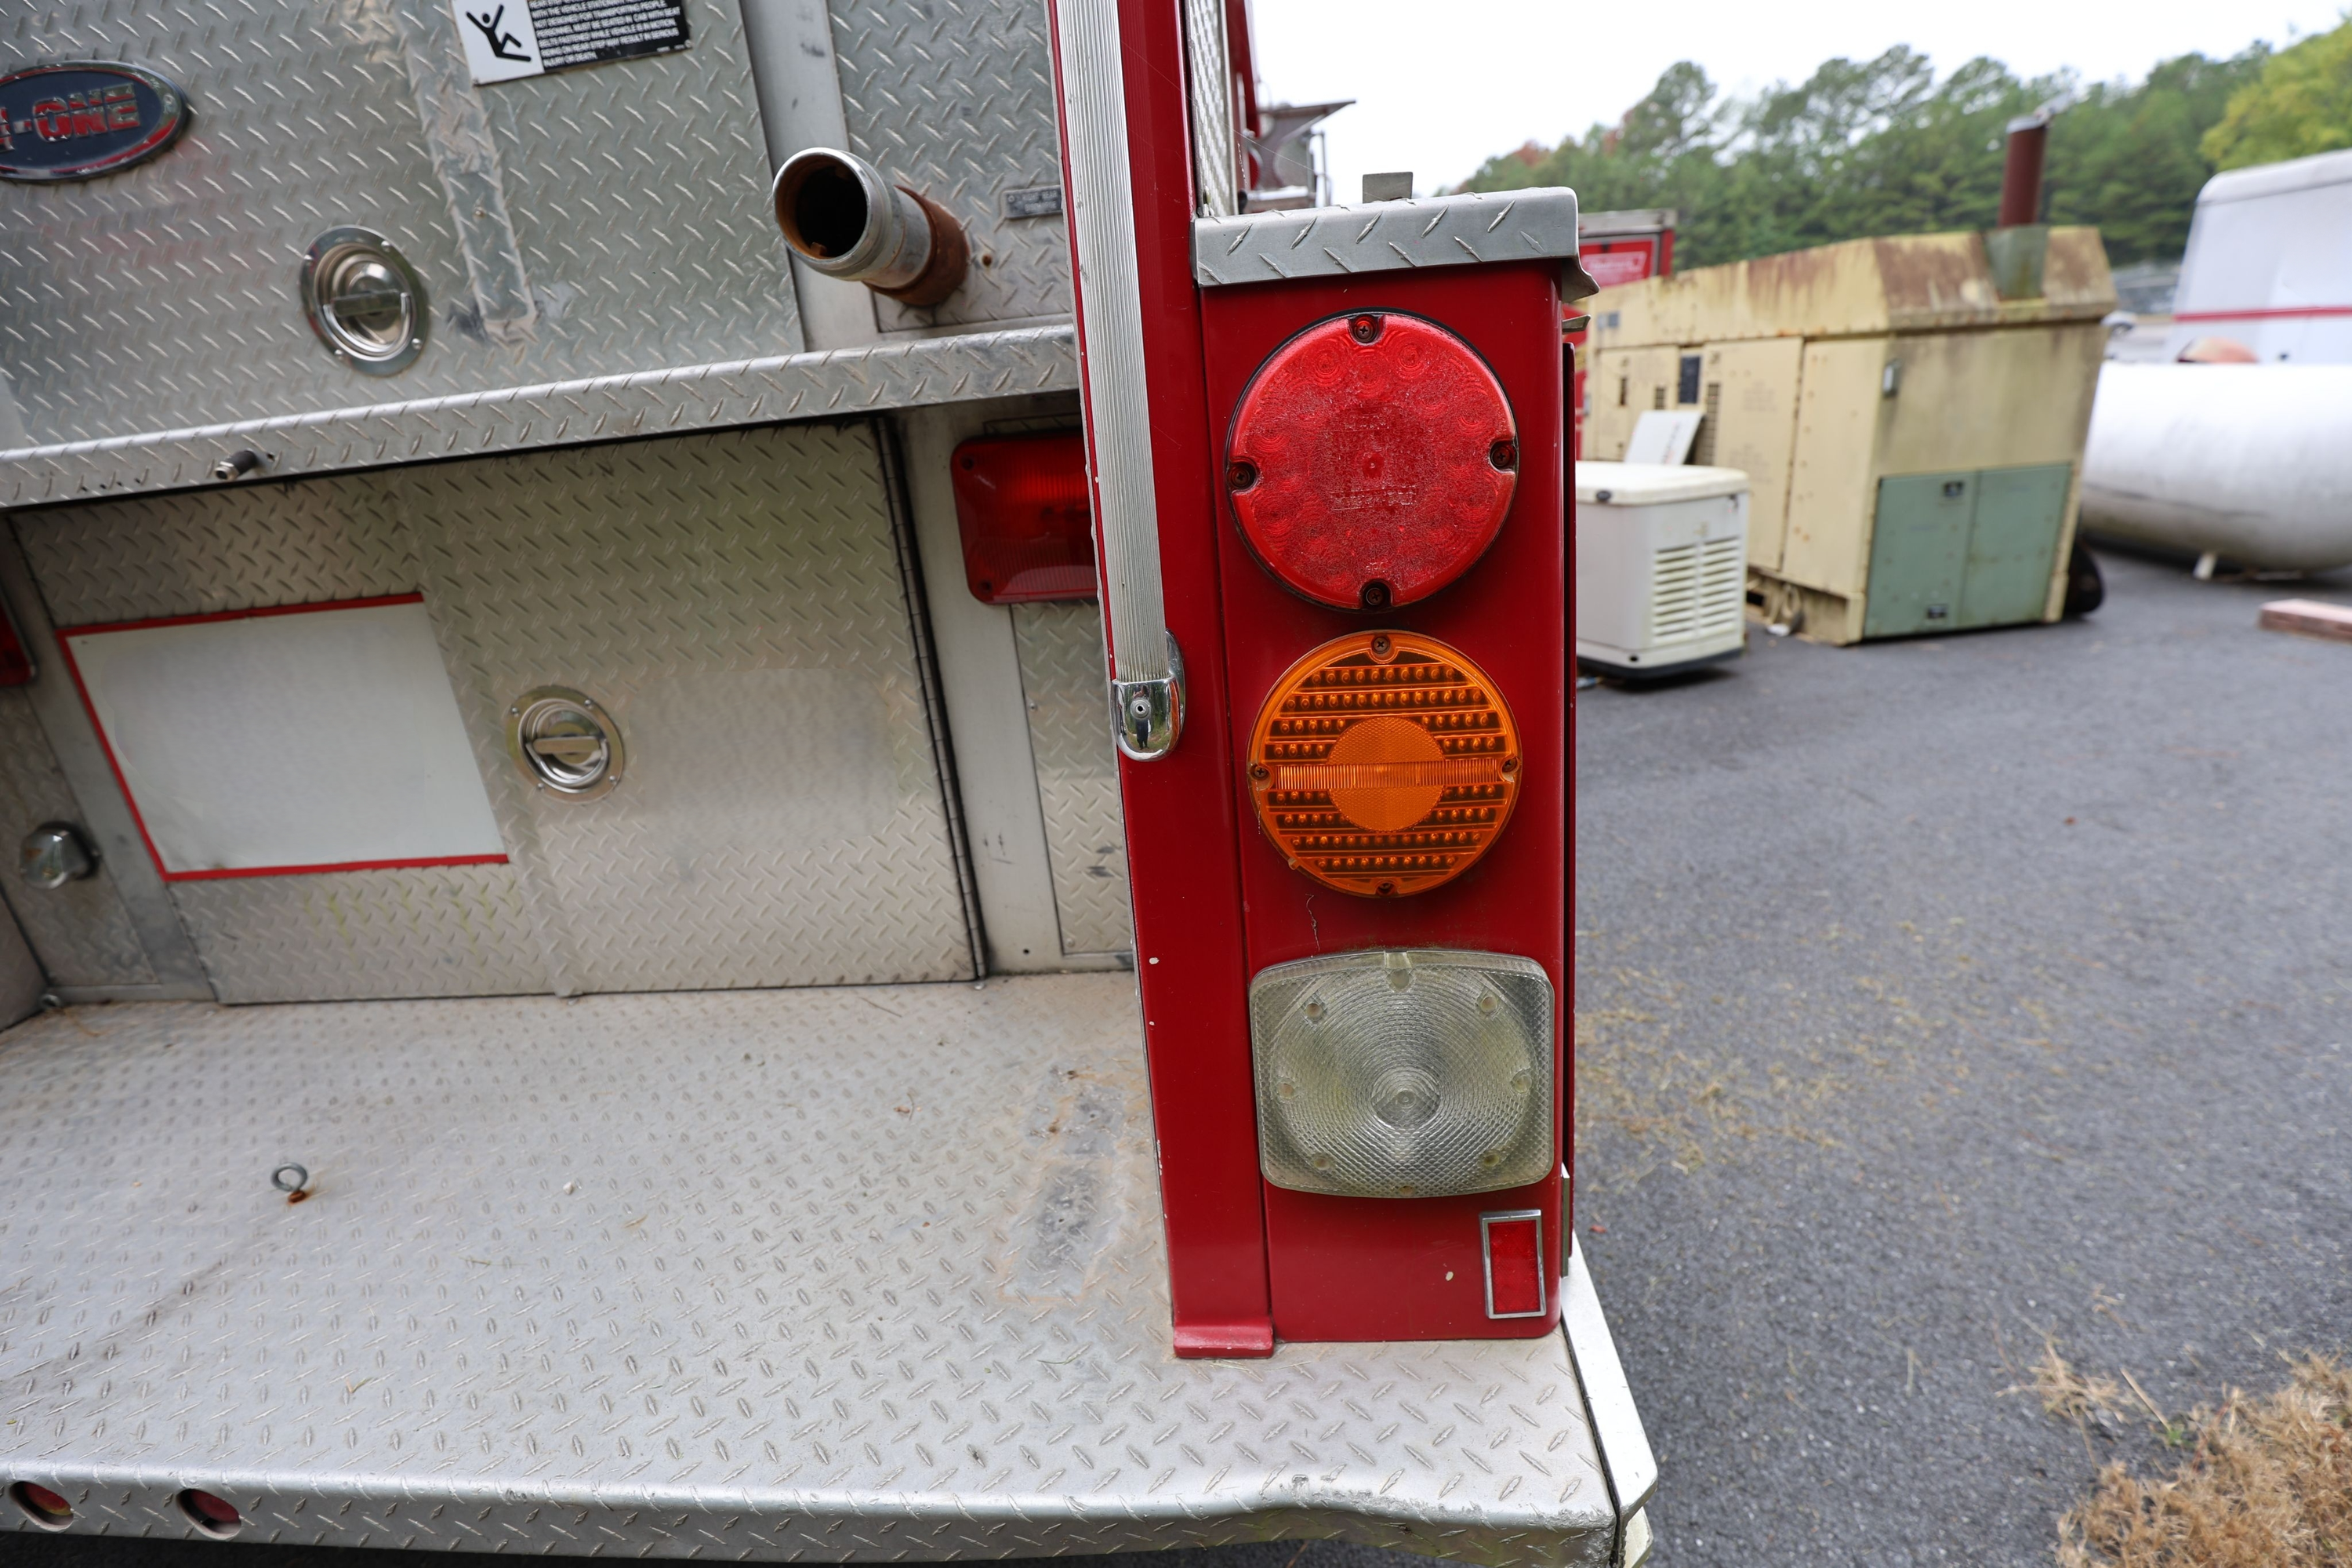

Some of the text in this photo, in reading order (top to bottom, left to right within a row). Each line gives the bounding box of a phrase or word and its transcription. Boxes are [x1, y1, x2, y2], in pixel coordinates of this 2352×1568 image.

[532, 9, 548, 19] WITH
[548, 7, 561, 16] THE
[561, 2, 587, 14] VEHICLE
[534, 19, 547, 28] NOT
[546, 13, 579, 26] DESIGNED
[579, 11, 593, 20] FOR
[593, 3, 640, 18] TRANSPORTING
[536, 7, 681, 38] PERSONNEL MUST BE SEATED IN CAB WITH SEAT
[539, 37, 558, 48] BELTS
[558, 32, 591, 45] FASTENED
[590, 28, 611, 39] WHILE
[611, 24, 636, 36] VEHICLE
[643, 22, 650, 31] IN
[541, 27, 680, 57] RIDING ON REAR STEP MAY RESULT IN SERIOUS
[543, 56, 564, 67] INJURY
[564, 54, 576, 64] OR
[1041, 191, 1058, 199] REAR
